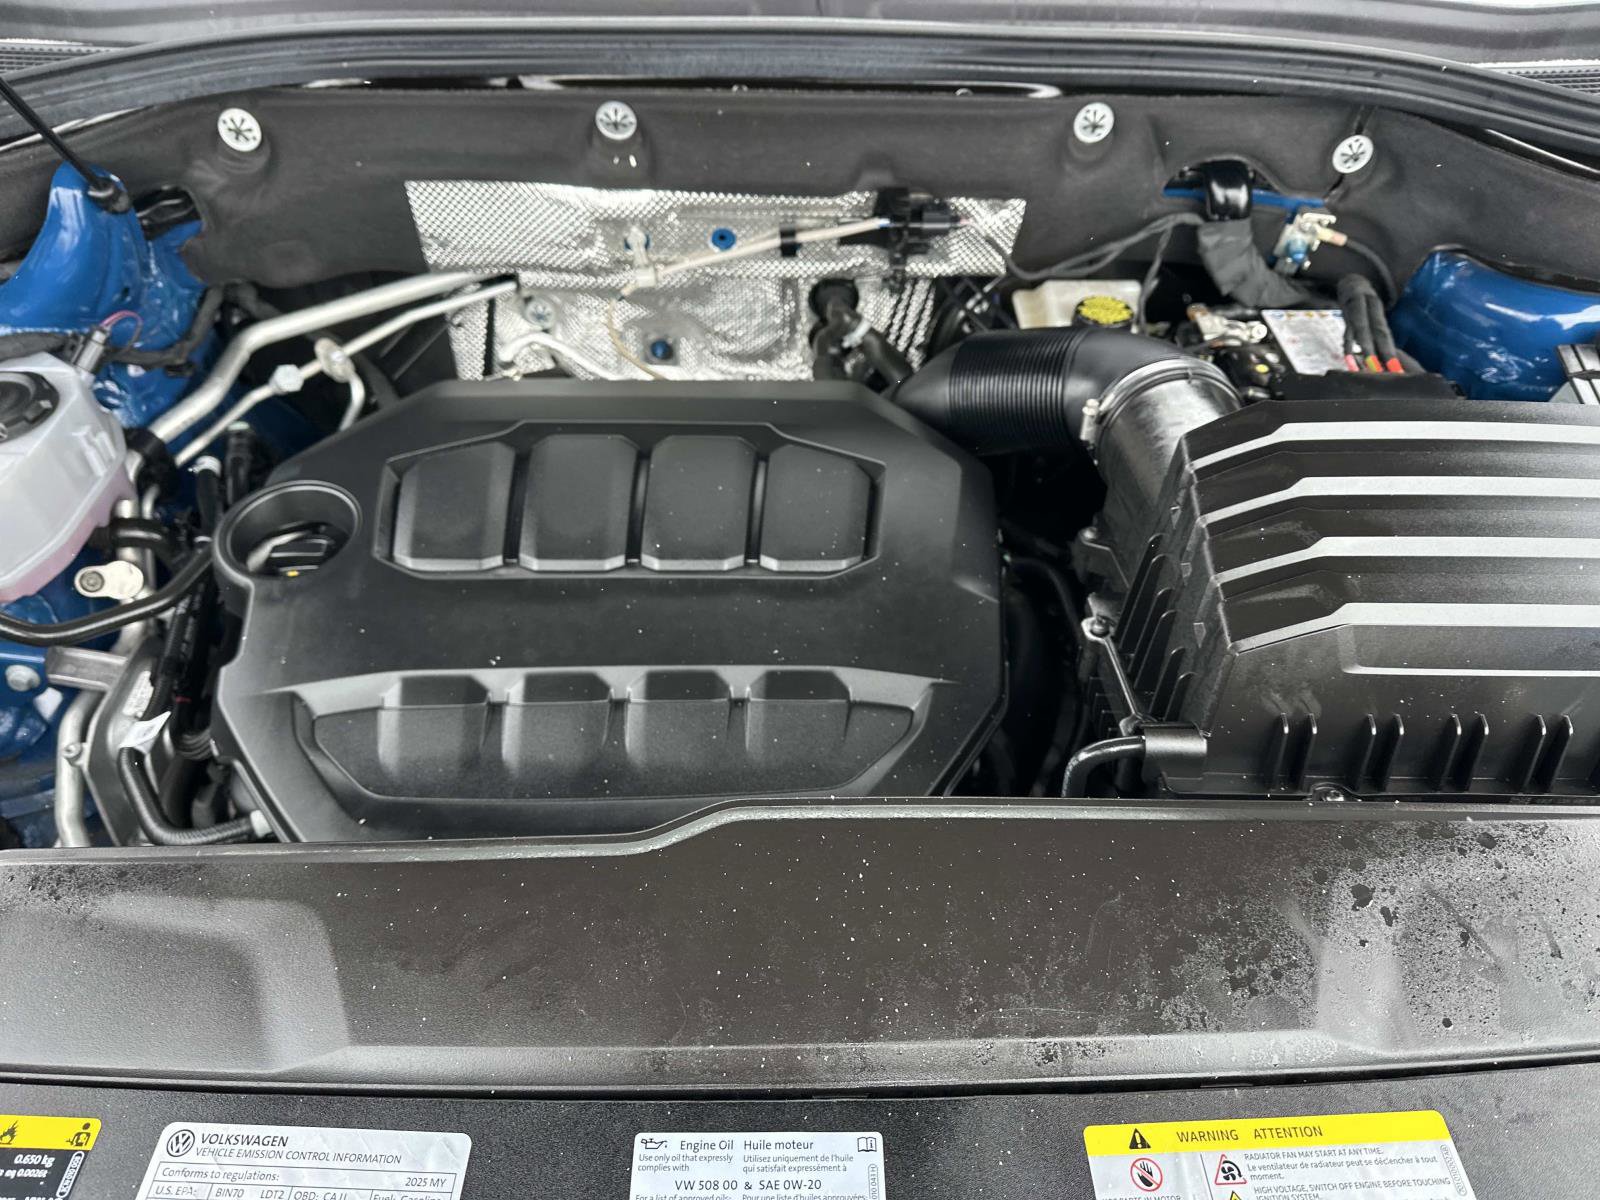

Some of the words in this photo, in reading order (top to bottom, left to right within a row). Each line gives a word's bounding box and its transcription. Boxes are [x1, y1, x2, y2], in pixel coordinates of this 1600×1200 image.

[200, 1132, 289, 1147] VOLKSWAGEN
[1176, 1129, 1239, 1143] WARNING
[1254, 1126, 1323, 1140] ATTENTION
[680, 1139, 716, 1153] Engine
[718, 1139, 734, 1150] Oil
[743, 1139, 772, 1150] Huile
[774, 1140, 814, 1150] moteur
[13, 1153, 42, 1165] 0.650
[41, 1154, 56, 1168] kg
[196, 1147, 236, 1158] VEHICLE
[236, 1148, 284, 1159] EMISSION
[285, 1150, 330, 1162] CONTROL
[333, 1152, 402, 1164] INFORMATION
[639, 1153, 653, 1162] Use
[654, 1153, 670, 1164] only
[671, 1153, 681, 1162] oil
[682, 1153, 698, 1162] that
[698, 1153, 734, 1164] expressly
[743, 1154, 771, 1163] Utilisez
[772, 1154, 819, 1164] uniquement
[819, 1154, 830, 1162] de
[1244, 1151, 1281, 1161] RADIATOR
[1282, 1150, 1297, 1159] FAN
[1298, 1149, 1313, 1158] MAY
[1314, 1149, 1336, 1158] START
[1338, 1148, 1347, 1157] AT
[1348, 1147, 1363, 1156] ANY
[637, 1163, 671, 1173] complies
[672, 1163, 690, 1172] with
[742, 1164, 756, 1174] qui
[757, 1164, 787, 1173] satisfait
[788, 1163, 841, 1174] expressément
[842, 1163, 847, 1172] à
[1247, 1163, 1257, 1172] Le
[1258, 1161, 1298, 1171] ventilateur
[1299, 1160, 1309, 1169] de
[1310, 1159, 1344, 1169] radiateur
[1345, 1159, 1364, 1168] peut
[1364, 1158, 1373, 1166] se
[1422, 1155, 1438, 1164] tout
[162, 1167, 208, 1179] Conforms
[210, 1169, 221, 1180] to
[222, 1169, 280, 1182] regulations:
[405, 1177, 428, 1187] 2025
[429, 1178, 447, 1188] MY
[674, 1180, 696, 1190] VW
[698, 1180, 720, 1190] 508
[722, 1180, 738, 1190] 00
[744, 1181, 753, 1190] &
[759, 1180, 780, 1190] SAE
[783, 1180, 822, 1190] 0W-20
[1253, 1185, 1273, 1194] HIGH
[1308, 1183, 1338, 1192] SWITCH
[1338, 1182, 1353, 1190] OFF
[1354, 1180, 1383, 1190] ENGINE
[1383, 1179, 1412, 1188] BEFORE
[1412, 1177, 1451, 1187] TOUCHING
[215, 1187, 245, 1198] BIN70
[259, 1189, 285, 1200] LDT2
